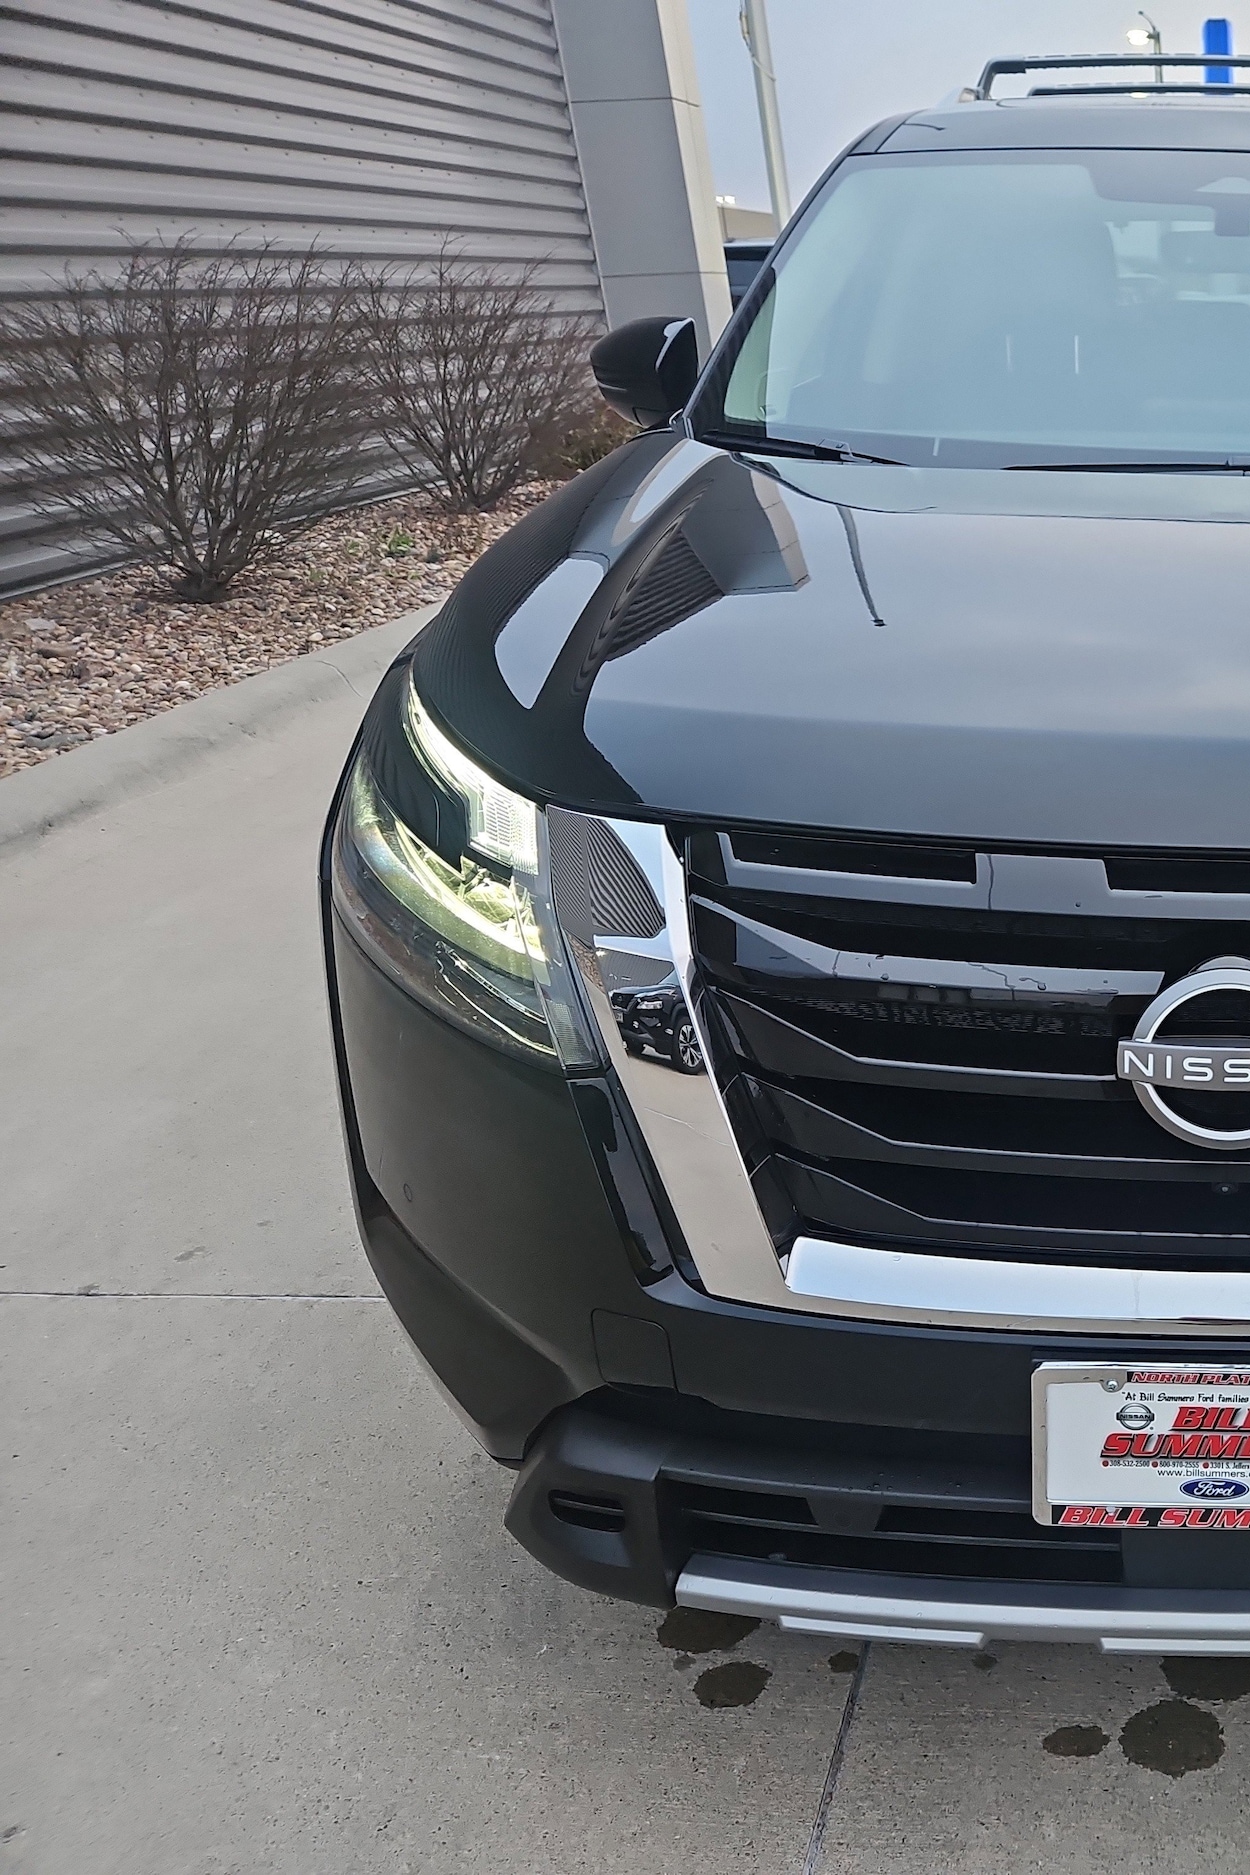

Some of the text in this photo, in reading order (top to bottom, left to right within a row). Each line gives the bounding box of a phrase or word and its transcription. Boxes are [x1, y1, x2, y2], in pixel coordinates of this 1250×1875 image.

[1131, 1372, 1199, 1384] NORTH
[1140, 1392, 1154, 1401] Bill
[1157, 1392, 1194, 1402] Summers
[1198, 1393, 1214, 1402] Ford
[1218, 1394, 1249, 1403] families
[1232, 1462, 1250, 1470] Jeffers
[1193, 1480, 1236, 1496] Ford
[1058, 1505, 1149, 1526] BILL
